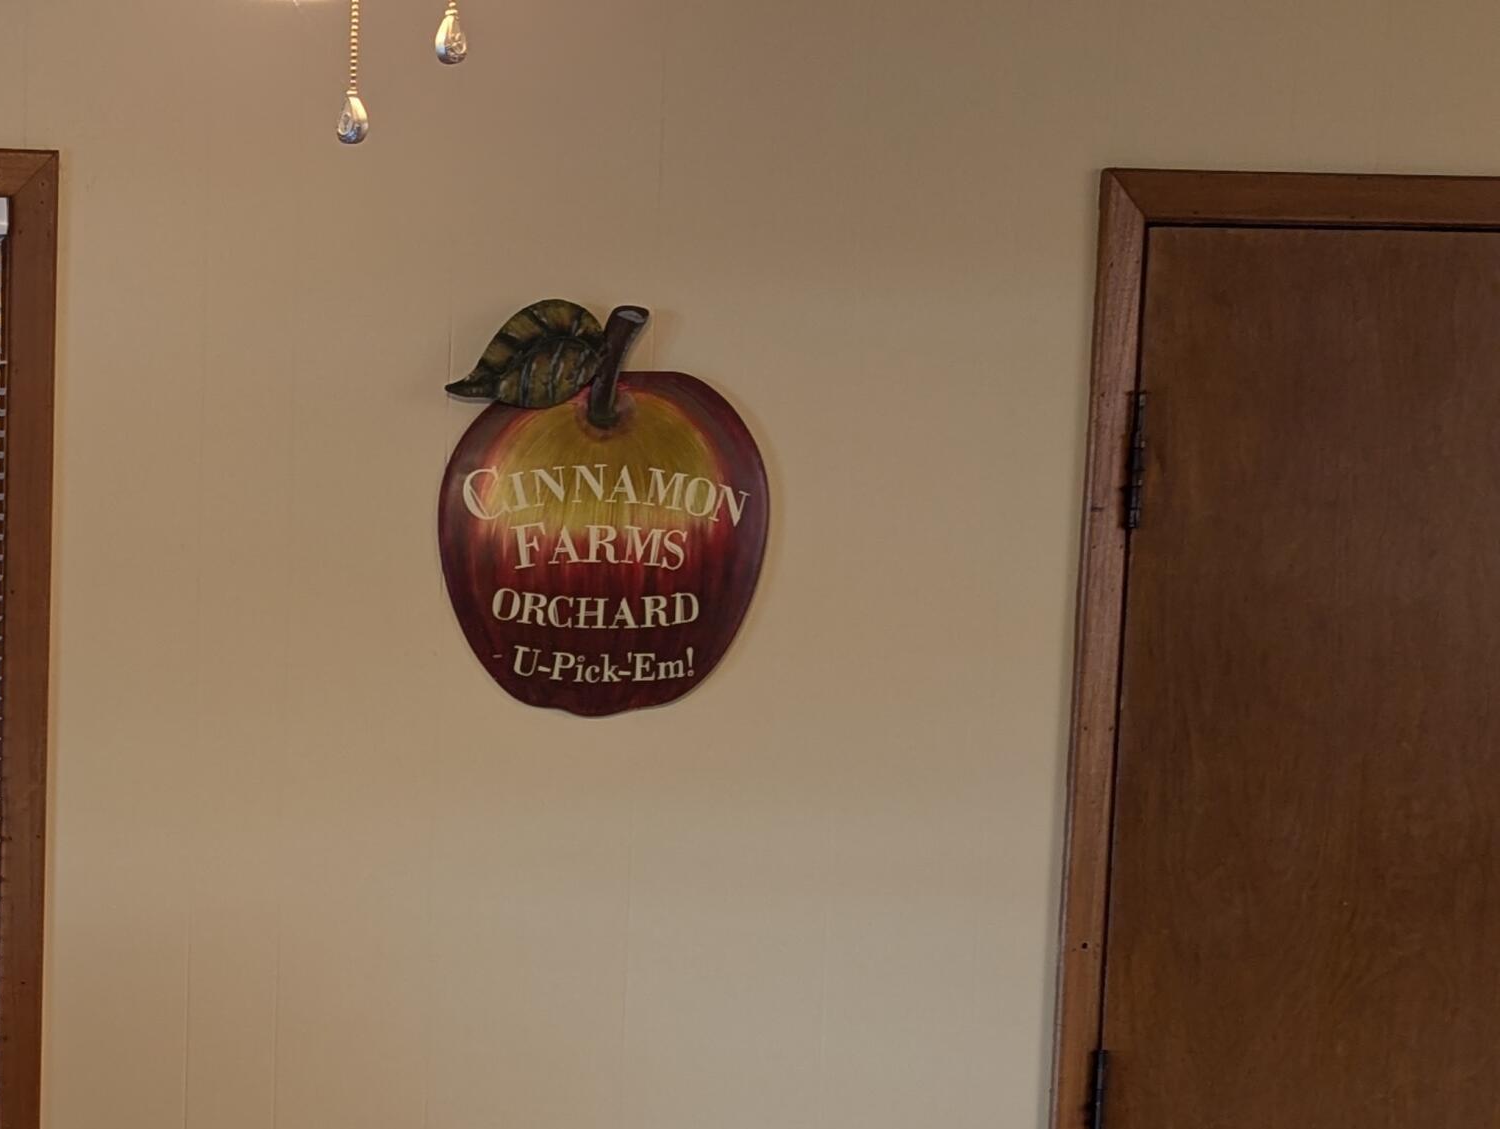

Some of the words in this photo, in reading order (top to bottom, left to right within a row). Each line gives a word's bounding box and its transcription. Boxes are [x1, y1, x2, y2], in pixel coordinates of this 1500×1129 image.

[463, 464, 750, 527] CINNAMON
[510, 522, 688, 570] FARMS
[491, 587, 700, 629] ORCHARD
[512, 645, 695, 683] U-Pick-'Em!
